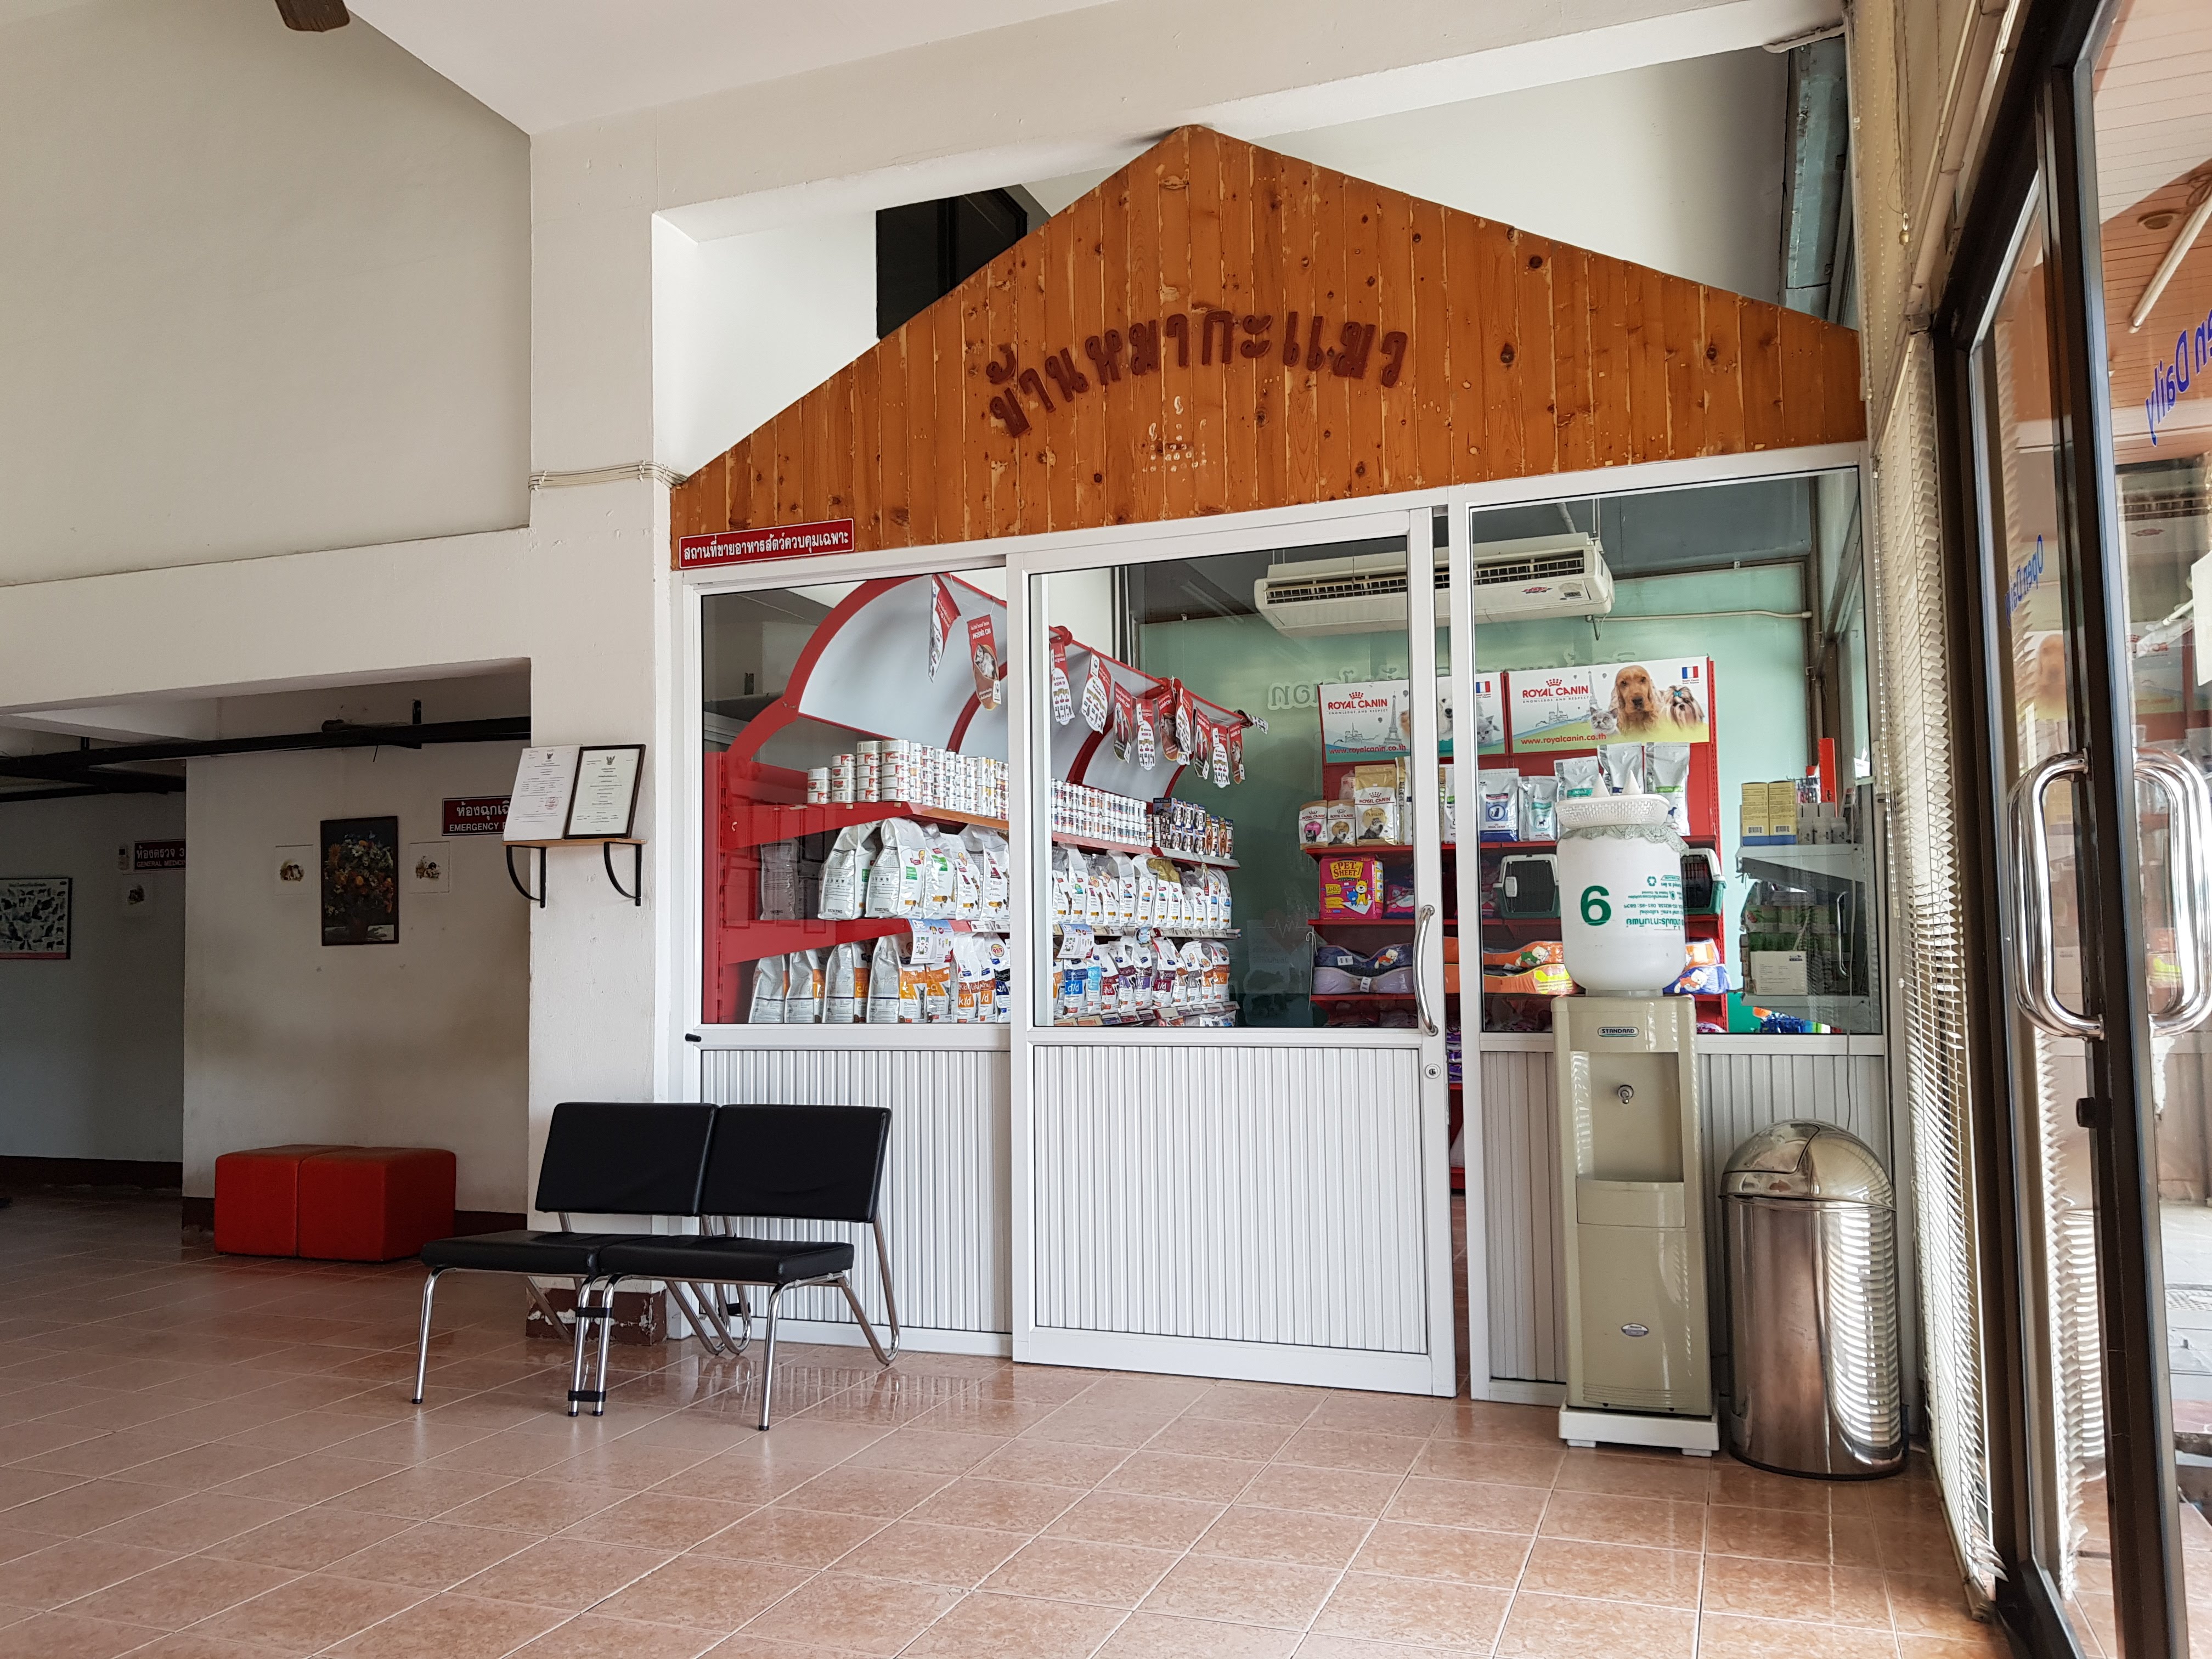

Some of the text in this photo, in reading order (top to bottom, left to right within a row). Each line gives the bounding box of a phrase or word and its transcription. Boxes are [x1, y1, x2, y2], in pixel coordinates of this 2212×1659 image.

[684, 531, 849, 560] สถานที่ขายอาหารสัตว์ควบคุมเฉพาะ
[1522, 685, 1588, 698] ROYAL CANIN
[1328, 698, 1387, 710] ROYAL CANIN
[1521, 733, 1606, 745] www.royalcanin.co.th
[1329, 744, 1406, 754] www.royalcanin.co.th
[456, 800, 510, 821] ห้องฉุกเฉิ
[449, 822, 499, 832] EMERGENCY
[136, 845, 175, 859] ห้องตรวจ
[1337, 861, 1356, 870] PET
[1333, 869, 1357, 878] SHEET
[958, 996, 972, 1006] k/d
